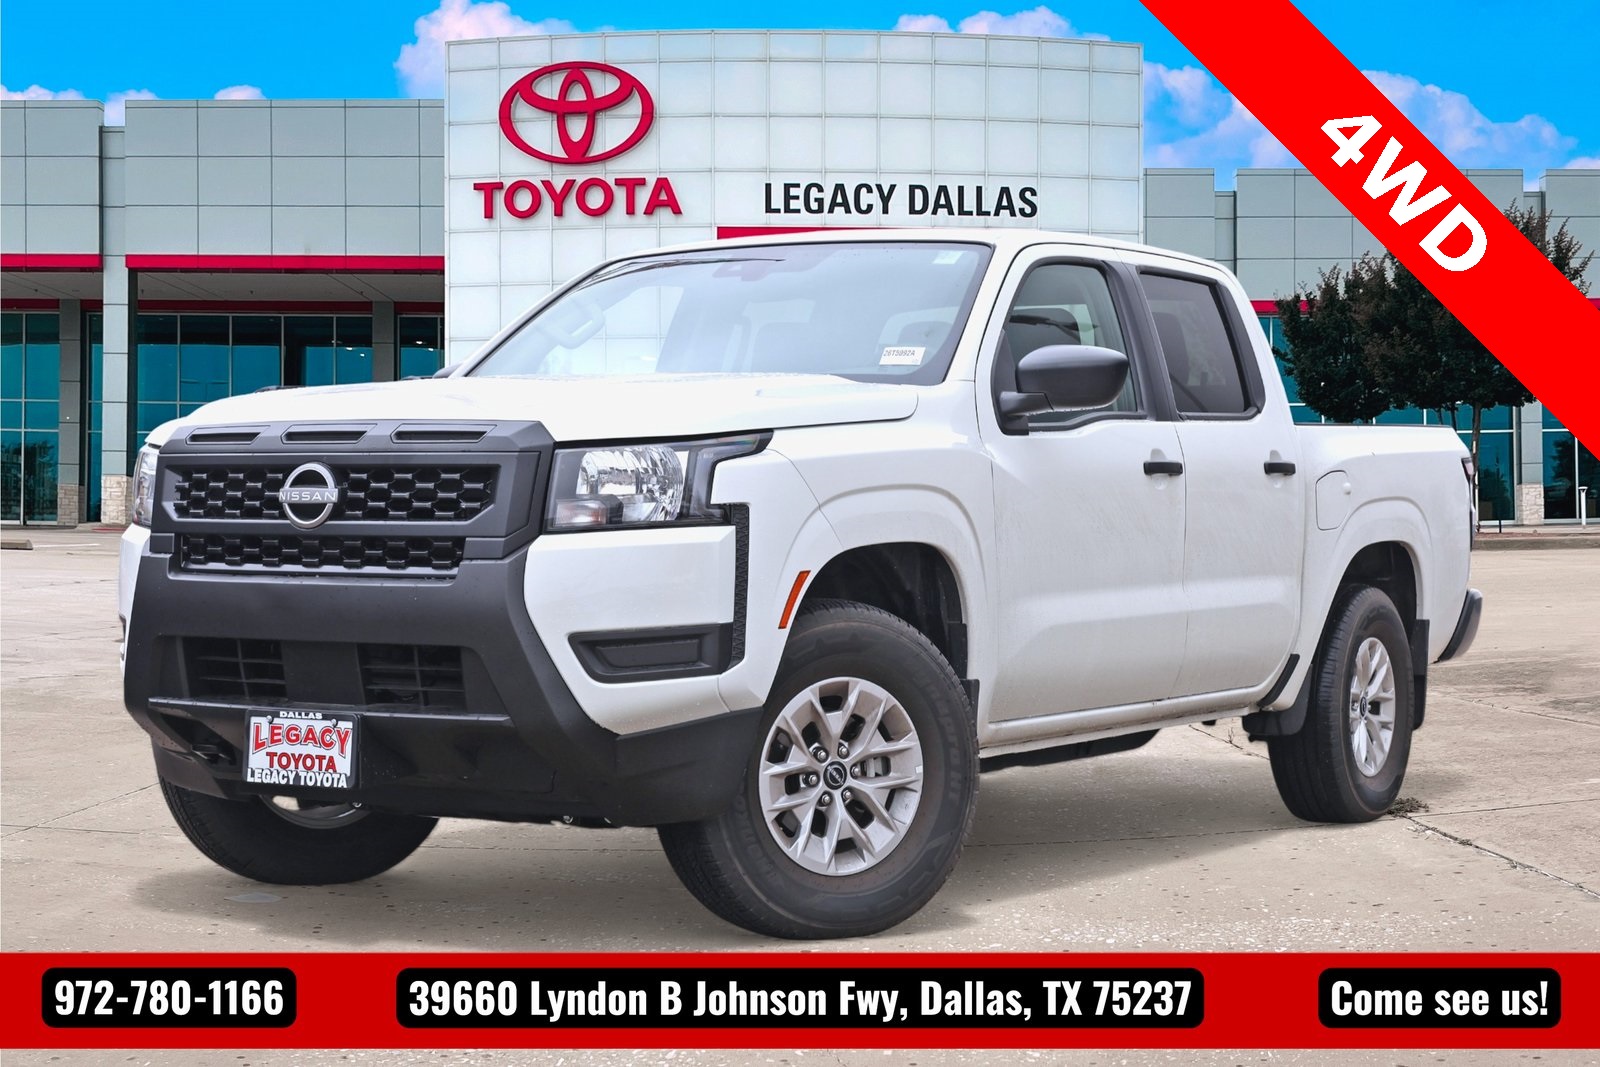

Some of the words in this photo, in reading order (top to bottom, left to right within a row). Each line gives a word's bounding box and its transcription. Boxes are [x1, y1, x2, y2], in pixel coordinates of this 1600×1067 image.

[474, 177, 681, 219] TOYOTA
[764, 182, 897, 215] LEGACY
[908, 184, 1038, 218] DALLAS
[279, 491, 336, 501] NISSAN
[279, 711, 323, 720] DALLAS
[252, 722, 352, 759] LEGACY
[266, 751, 337, 772] TOYOTA
[247, 767, 297, 785] LEGACY
[299, 770, 347, 788] TOYOTA
